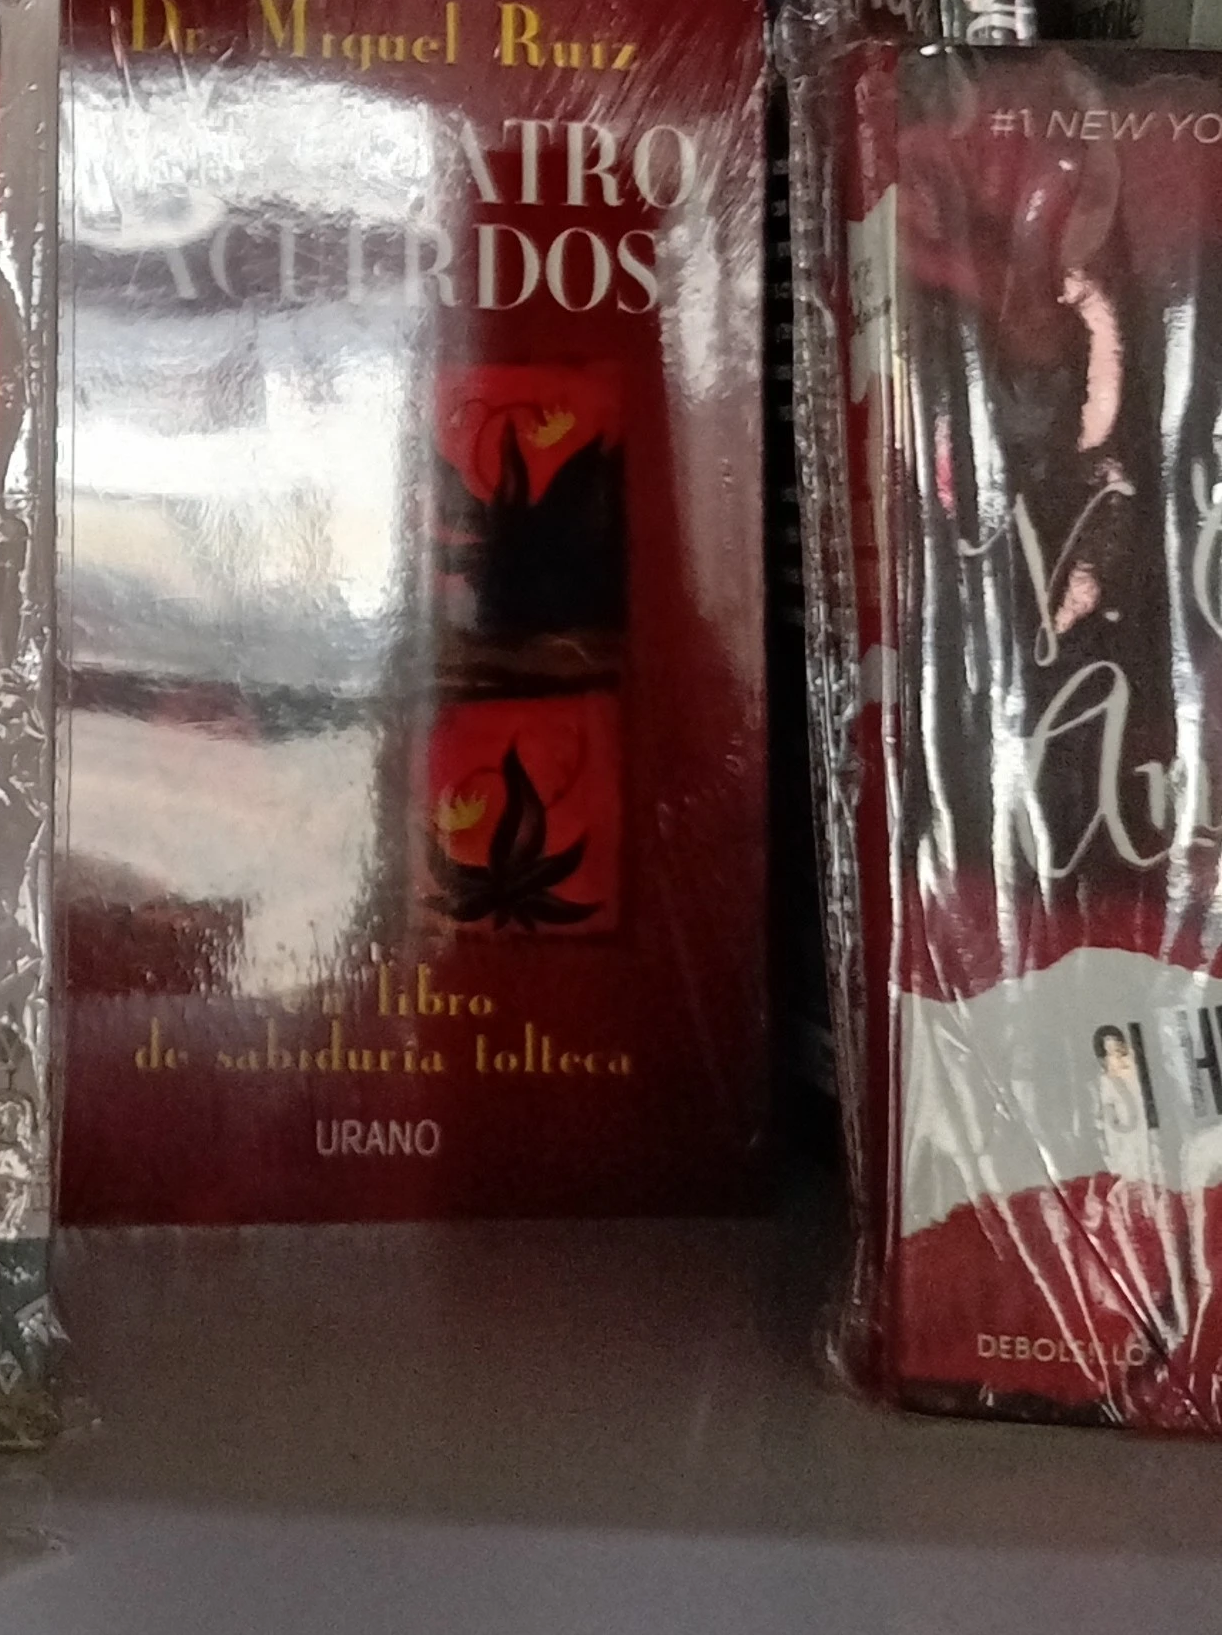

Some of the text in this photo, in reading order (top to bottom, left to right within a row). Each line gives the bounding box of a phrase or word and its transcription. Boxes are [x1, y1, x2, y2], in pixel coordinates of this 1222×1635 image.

[499, 1, 639, 71] Ruiz
[989, 108, 1034, 139] #1
[1046, 109, 1154, 142] NEW
[458, 116, 698, 210] ATRO
[375, 962, 497, 1016] libro
[134, 1016, 189, 1073] de
[315, 1118, 443, 1158] URANO
